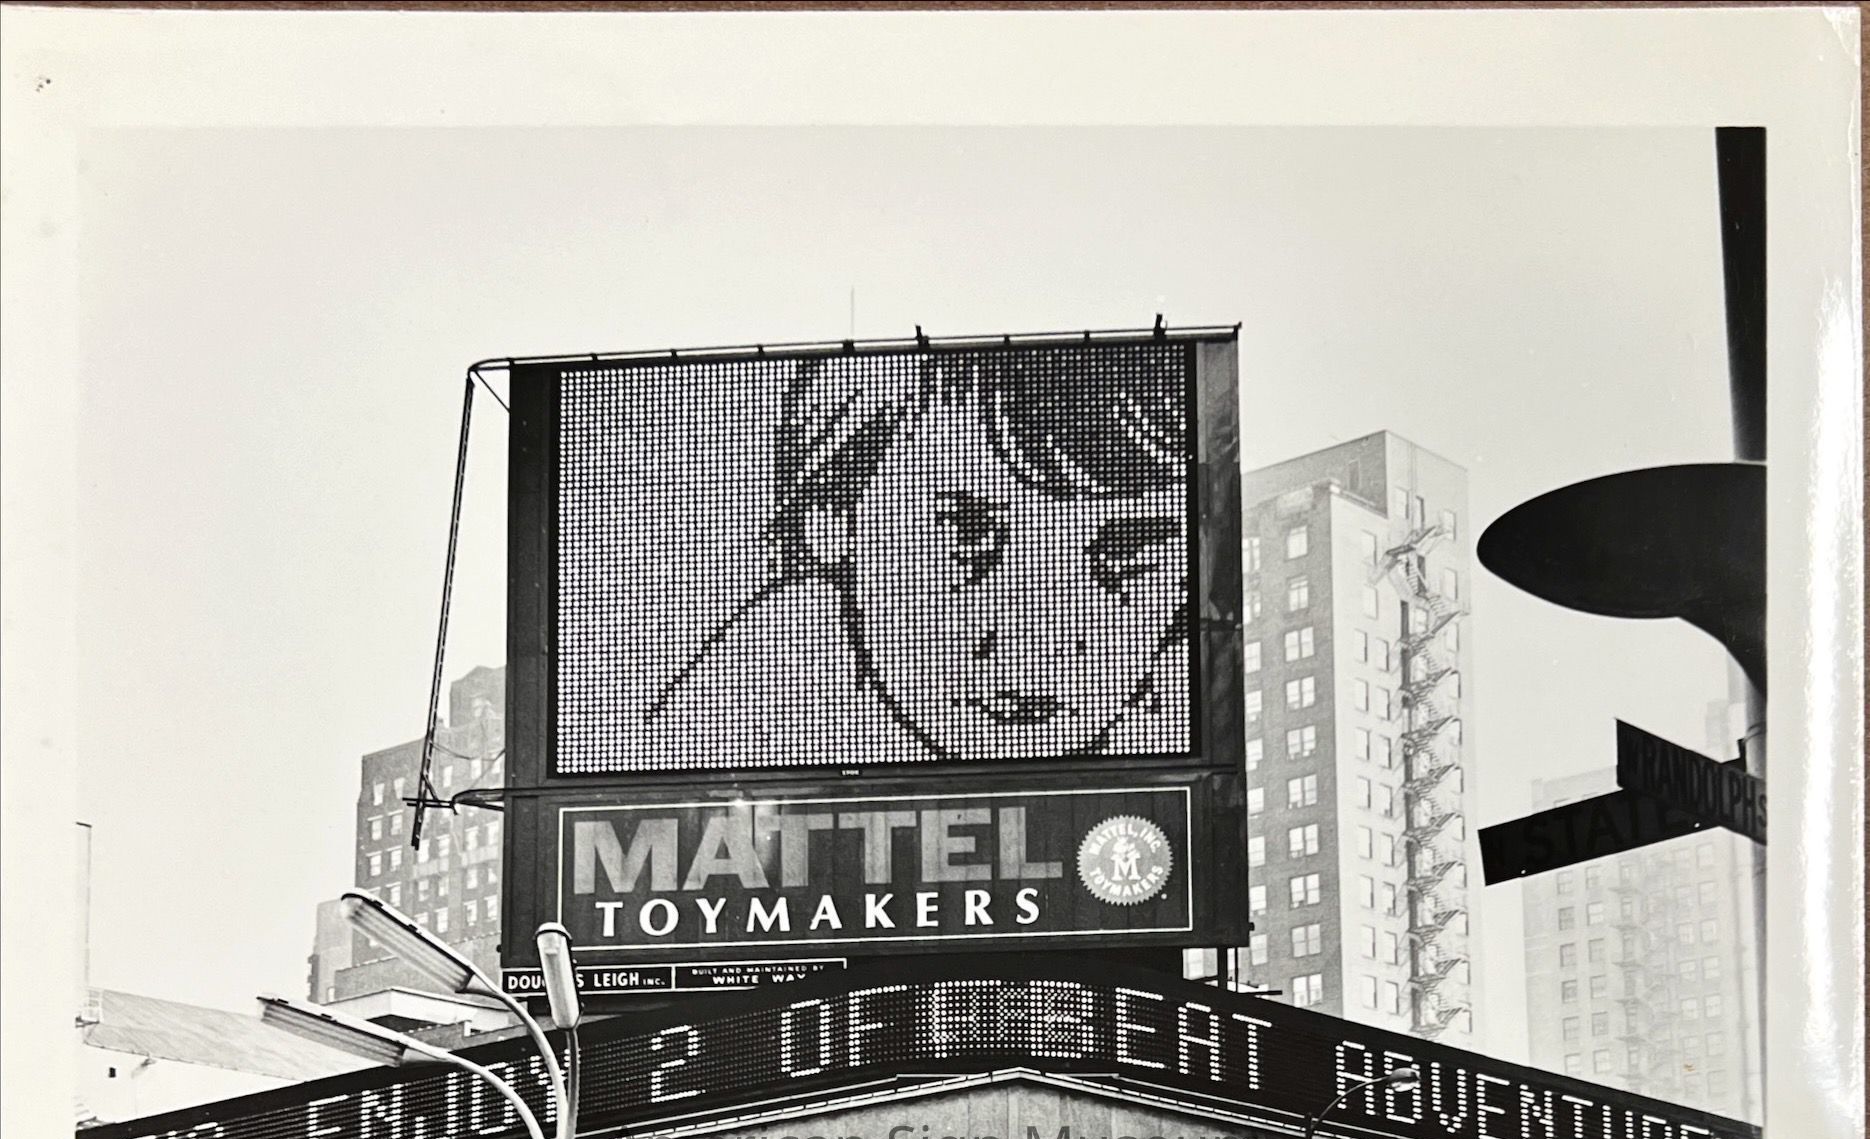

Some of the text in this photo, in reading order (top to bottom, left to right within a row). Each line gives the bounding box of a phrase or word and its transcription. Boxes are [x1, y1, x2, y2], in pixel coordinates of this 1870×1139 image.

[573, 806, 1063, 895] MATTEL
[595, 887, 1042, 938] TOYMAKERS
[508, 974, 585, 991] DOUS
[593, 972, 640, 988] LEIGH
[712, 975, 759, 985] WHITE
[721, 966, 742, 975] AND
[746, 965, 807, 974] MAINTAINED
[651, 1025, 706, 1103] 2
